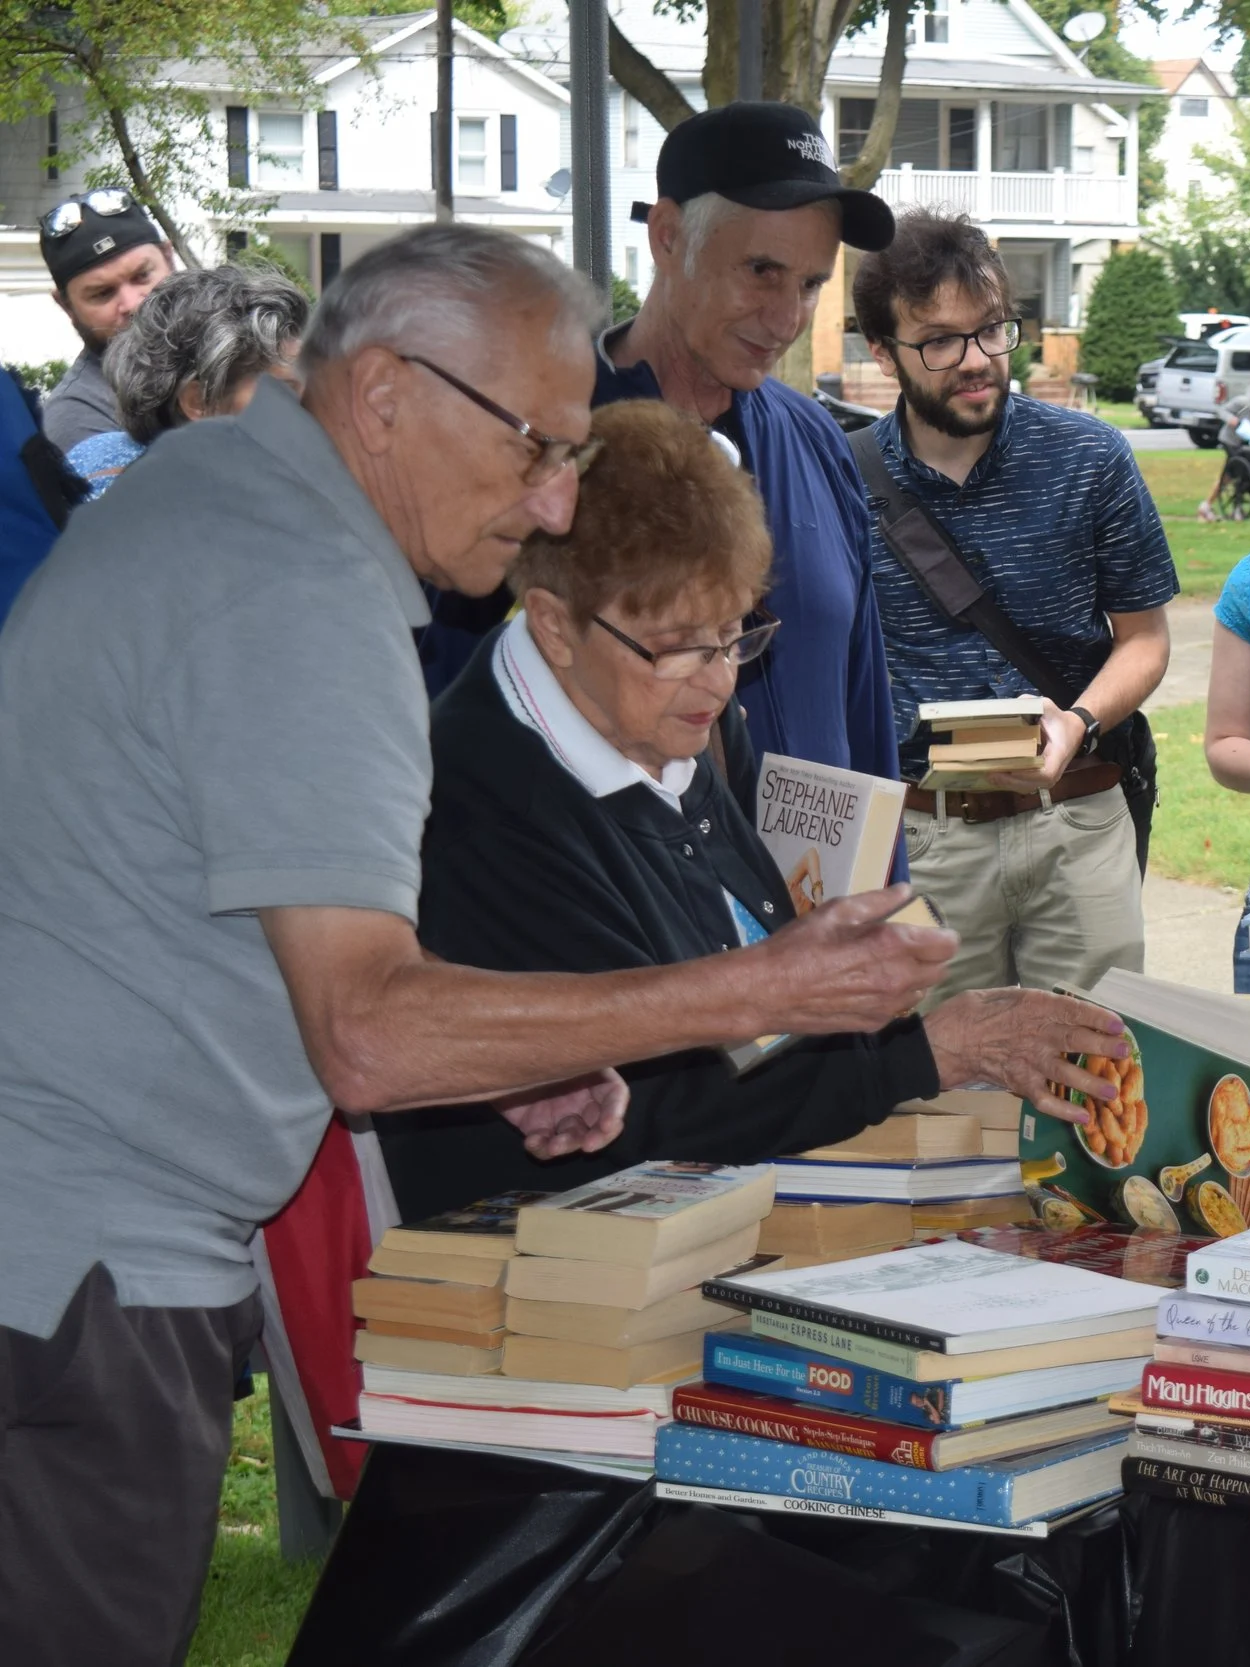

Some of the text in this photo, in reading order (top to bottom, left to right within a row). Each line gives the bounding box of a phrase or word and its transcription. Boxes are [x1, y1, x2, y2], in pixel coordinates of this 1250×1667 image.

[762, 769, 858, 821] STEPHANIE
[761, 803, 844, 847] LAURENS
[787, 1305, 869, 1333] SUSTAINABLE
[876, 1325, 921, 1345] LIVING
[1166, 1303, 1201, 1331] Queen
[1206, 1312, 1219, 1334] of
[1219, 1309, 1240, 1332] the
[790, 1322, 829, 1345] EXPRESS
[830, 1335, 852, 1352] LANE
[717, 1351, 852, 1391] I'm Just Here For the FOOD
[864, 1374, 872, 1408] Alton
[871, 1374, 881, 1411] Brown
[1148, 1375, 1195, 1407] Mary
[676, 1404, 736, 1431] CHINESE
[735, 1415, 800, 1443] COOKING
[841, 1432, 877, 1449] Techniques
[1135, 1440, 1155, 1453] Thich
[1207, 1451, 1226, 1466] Zen
[791, 1468, 855, 1500] COUNTRY
[1137, 1461, 1159, 1478] THE
[1162, 1466, 1187, 1482] ART
[1189, 1471, 1205, 1486] OF
[664, 1487, 688, 1499] Better
[688, 1489, 717, 1502] Homes
[717, 1492, 733, 1503] and
[783, 1499, 836, 1515] COOKING
[837, 1505, 886, 1520] CHINESE
[807, 1485, 845, 1499] RECIPES
[1176, 1486, 1227, 1506] AT WORK
